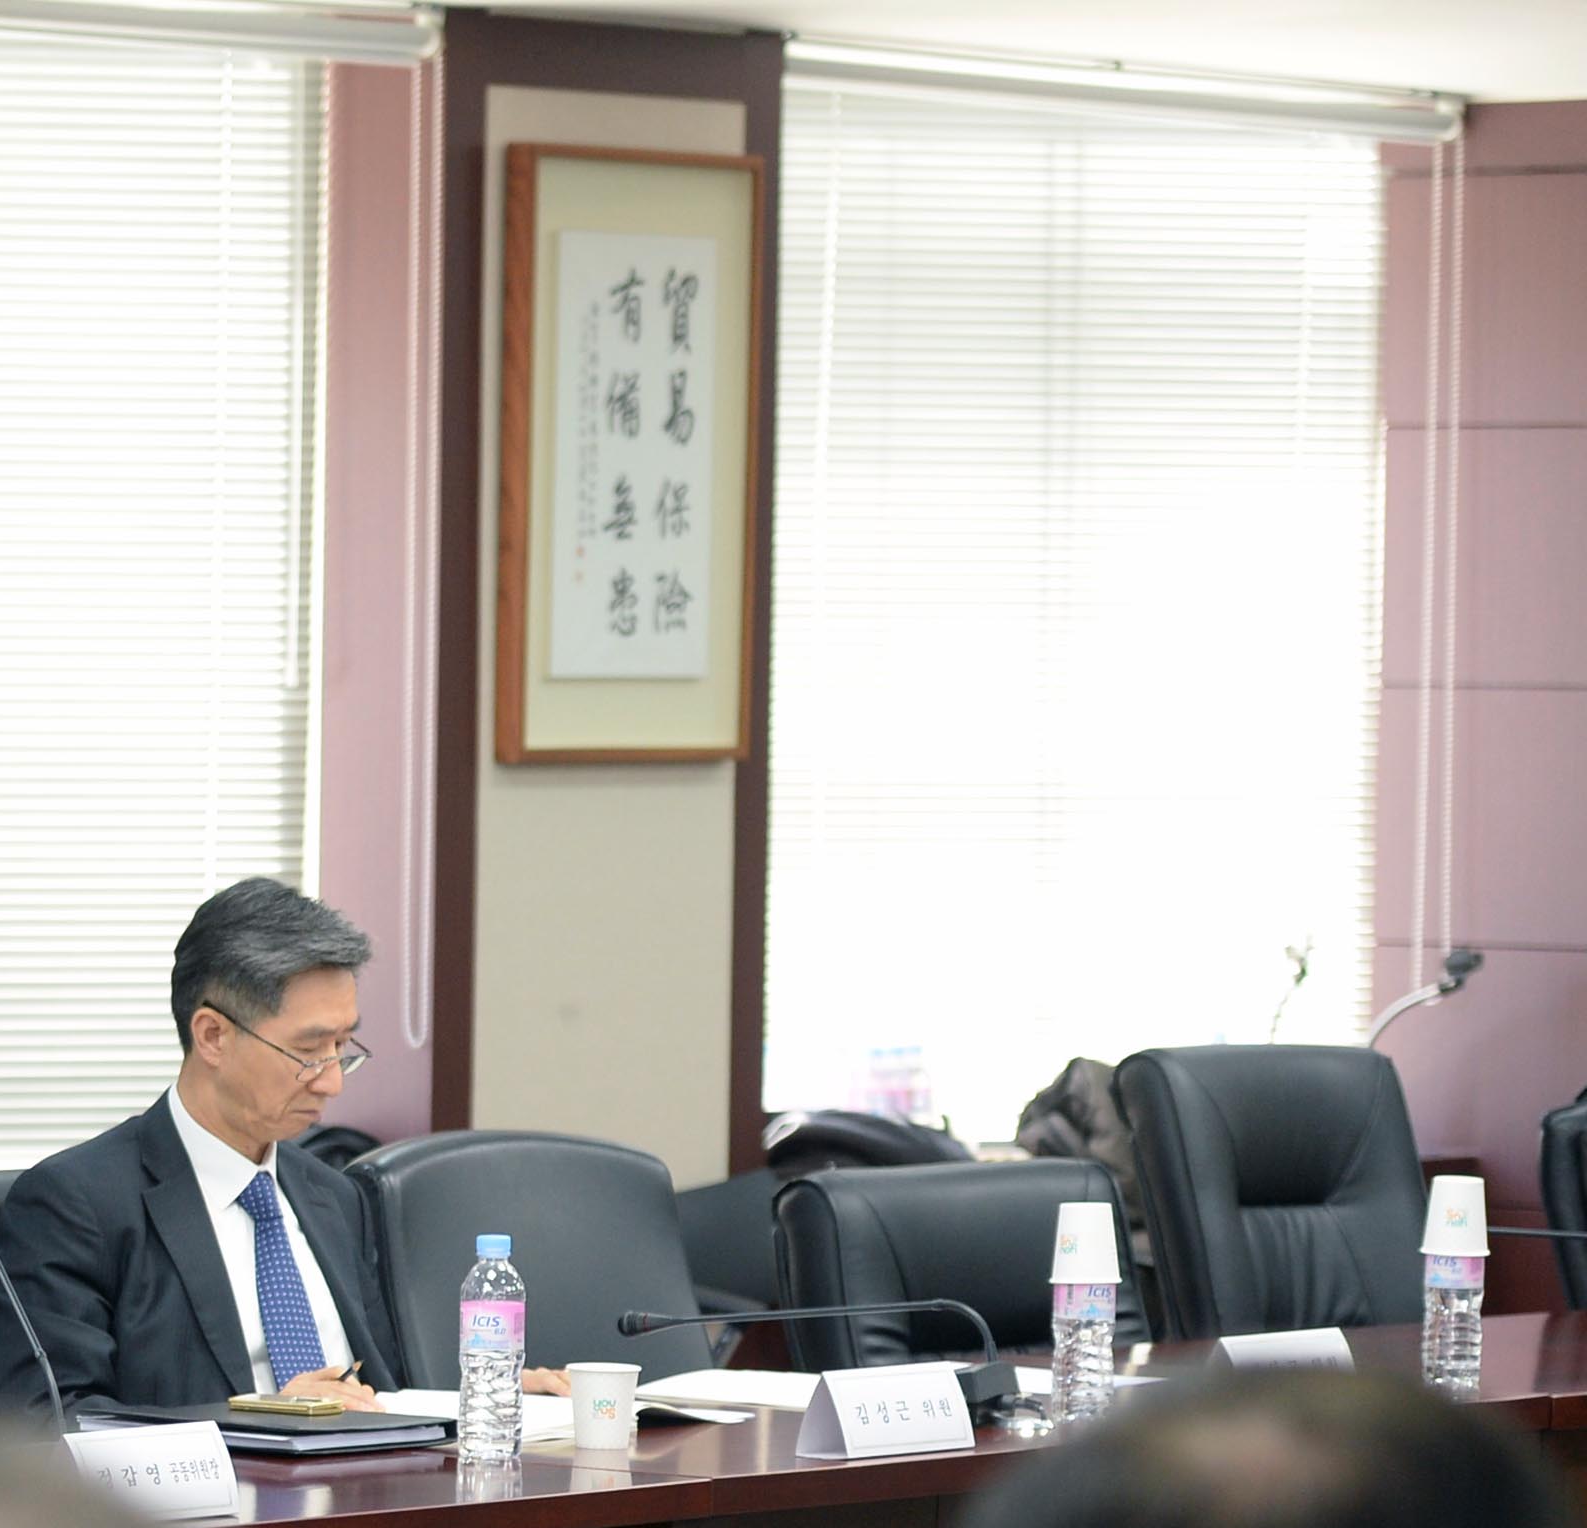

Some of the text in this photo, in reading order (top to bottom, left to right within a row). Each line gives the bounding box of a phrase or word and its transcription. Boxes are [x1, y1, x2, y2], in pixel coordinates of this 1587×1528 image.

[472, 1315, 501, 1327] ICIS
[855, 1397, 953, 1425] 김성근 위원
